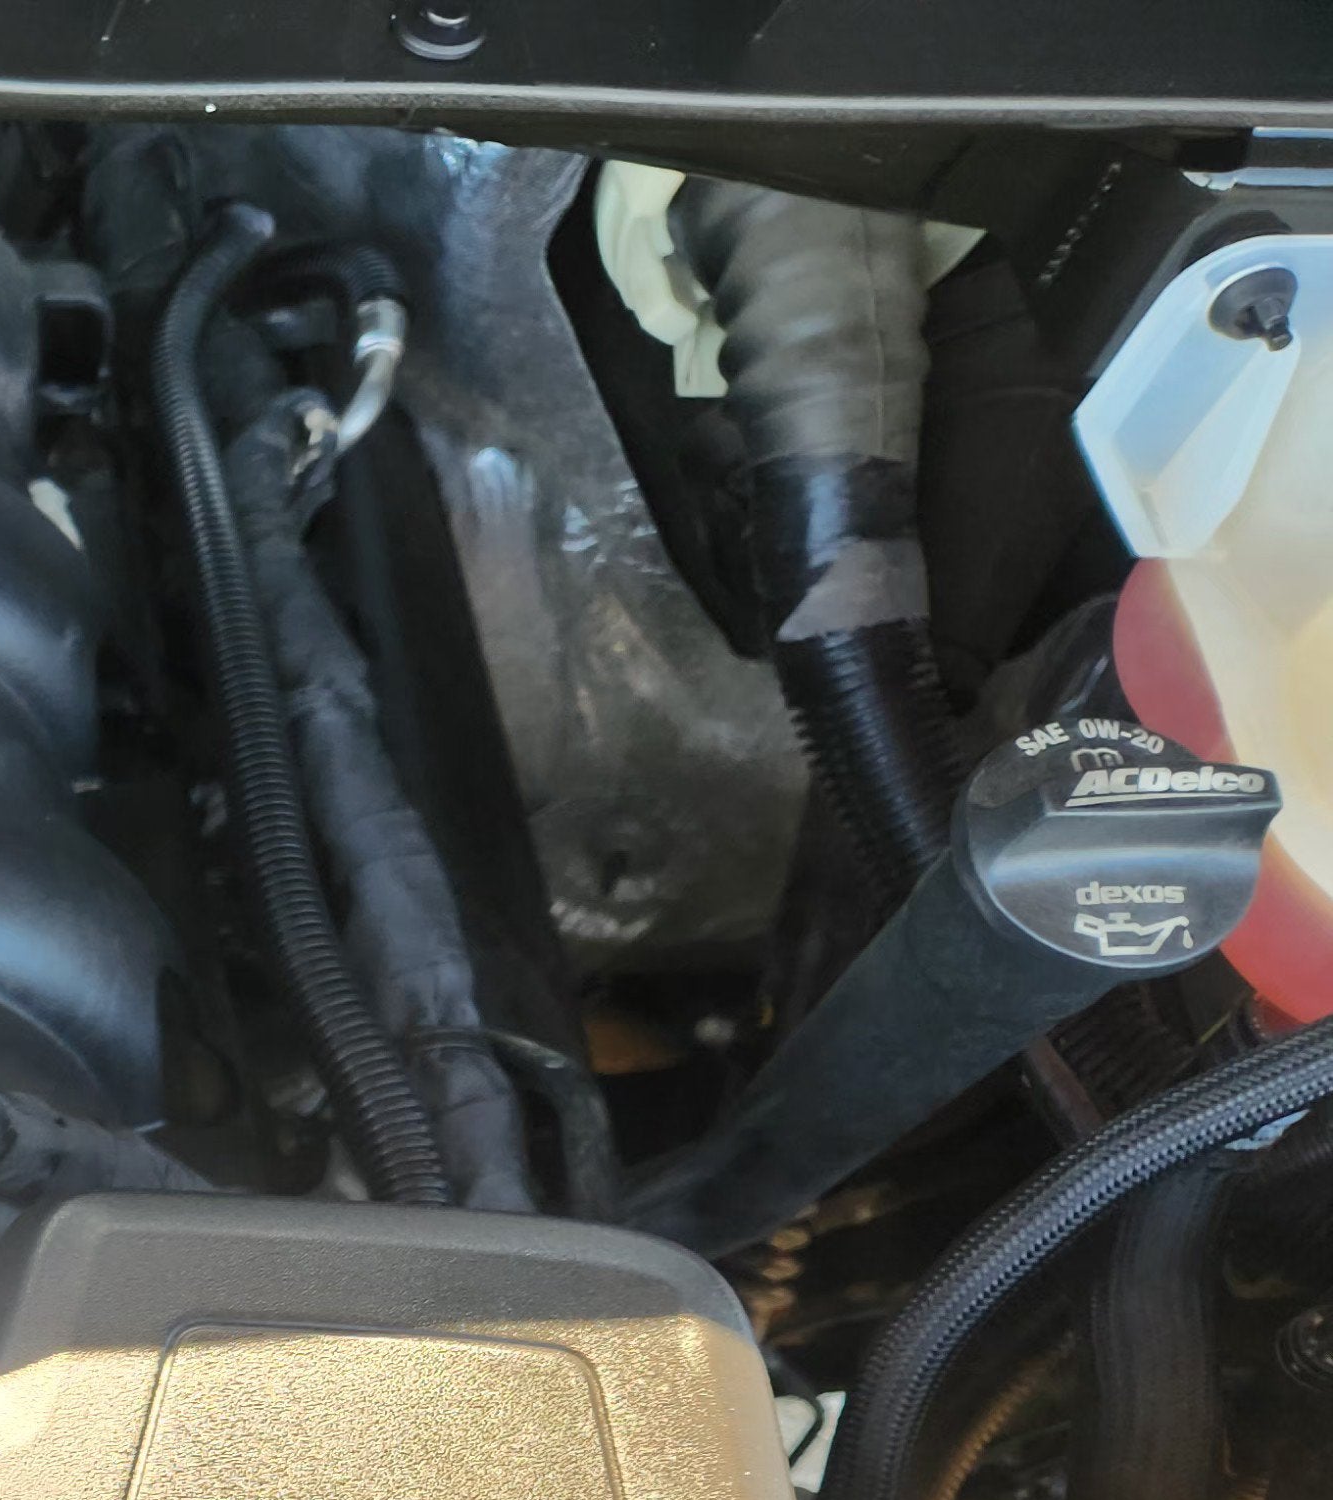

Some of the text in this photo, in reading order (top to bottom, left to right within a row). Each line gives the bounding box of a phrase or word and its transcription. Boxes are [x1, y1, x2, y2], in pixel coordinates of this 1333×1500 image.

[1015, 722, 1071, 757] SAE
[1070, 765, 1266, 798] ACDelco
[1075, 880, 1188, 906] dexos
